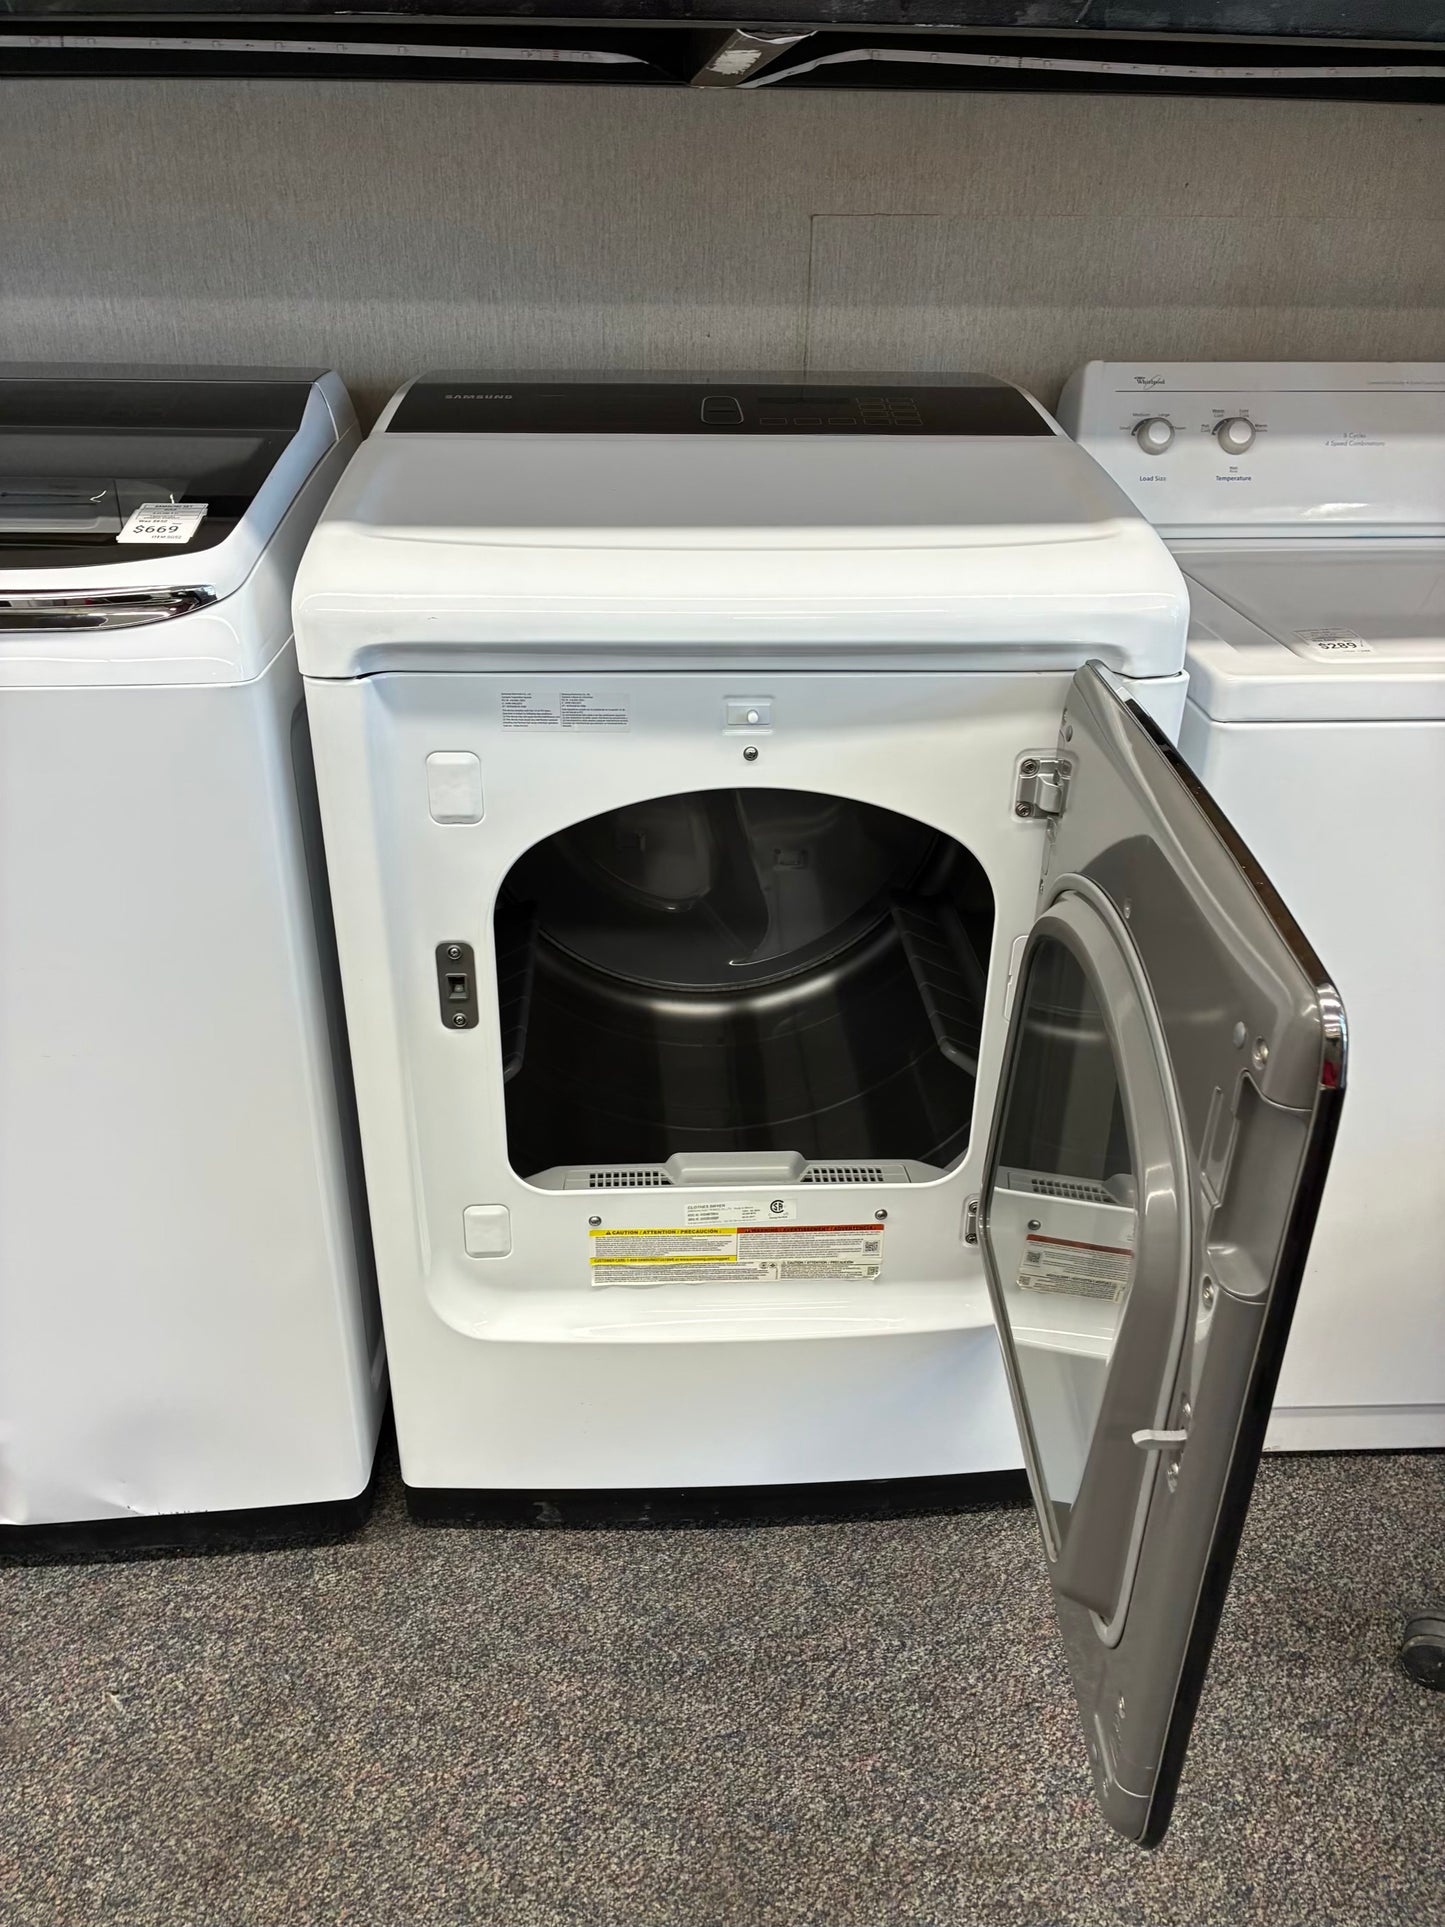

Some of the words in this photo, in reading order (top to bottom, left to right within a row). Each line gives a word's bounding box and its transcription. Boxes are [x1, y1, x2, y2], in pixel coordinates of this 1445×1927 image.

[1133, 375, 1165, 388] Whirlpool
[133, 525, 179, 534] $669
[1318, 642, 1357, 650] $289
